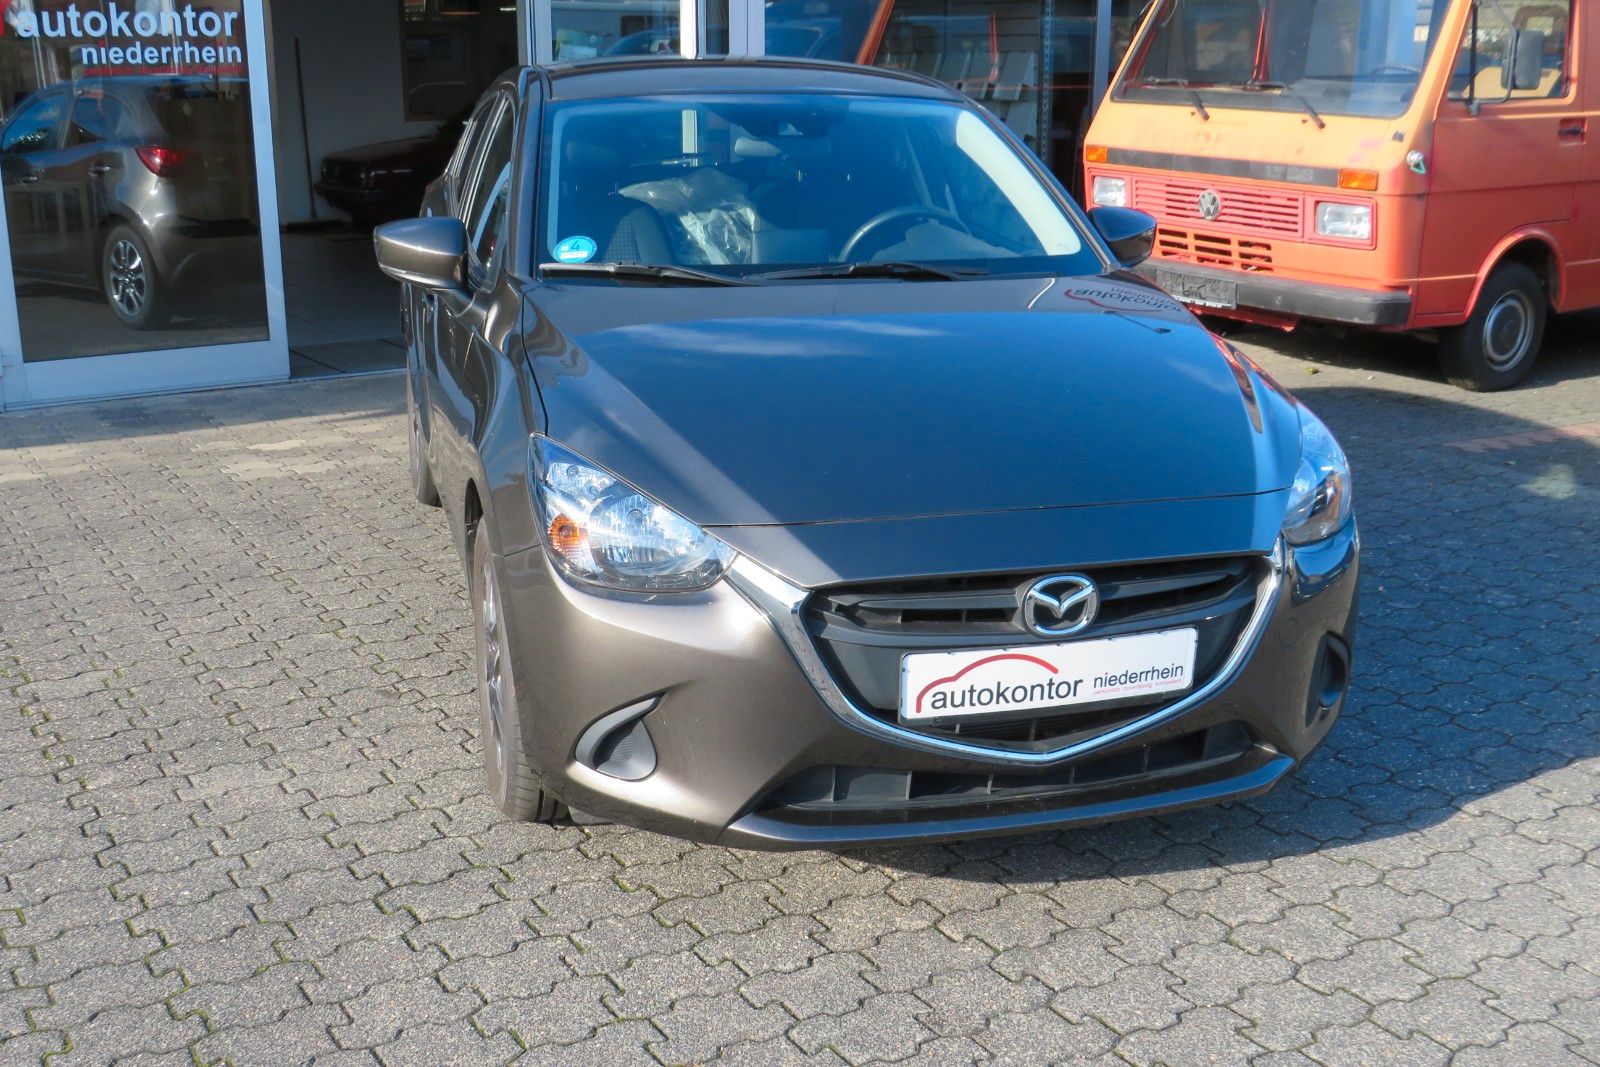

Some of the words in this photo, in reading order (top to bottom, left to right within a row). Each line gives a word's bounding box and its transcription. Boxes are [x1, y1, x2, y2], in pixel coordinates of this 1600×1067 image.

[16, 2, 238, 38] autokontor
[81, 40, 242, 65] niederrhein
[1093, 662, 1185, 689] niederrhein
[930, 677, 1084, 710] autokontor
